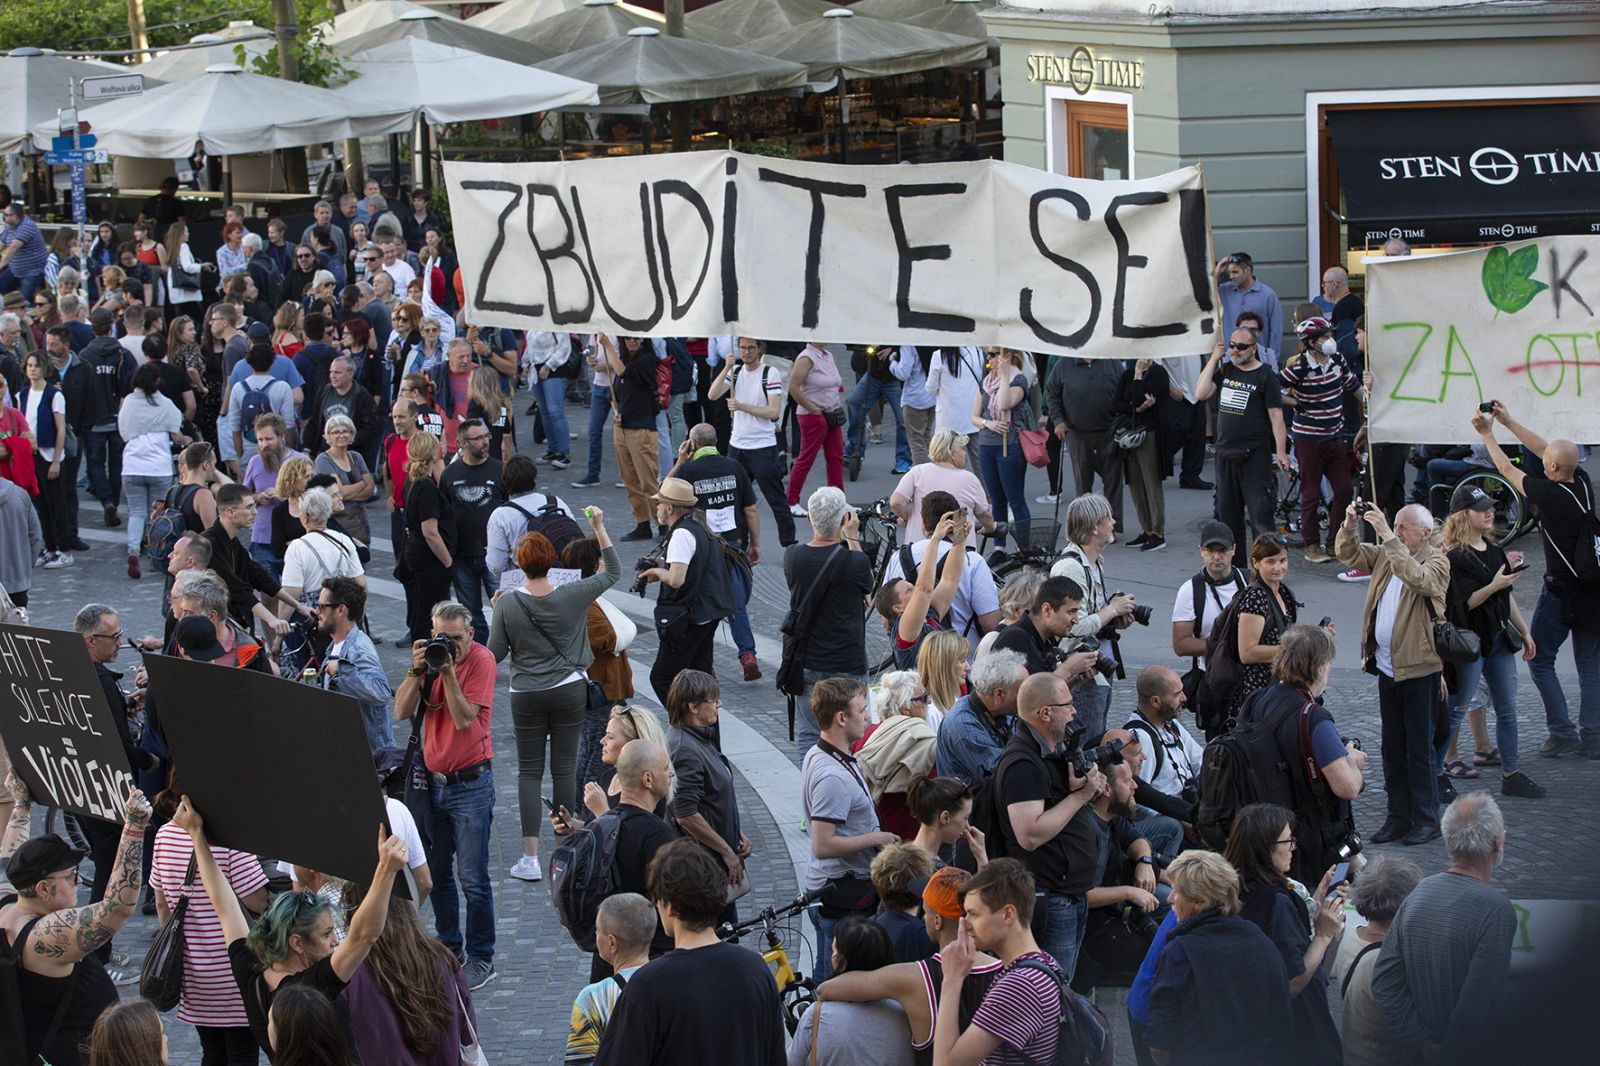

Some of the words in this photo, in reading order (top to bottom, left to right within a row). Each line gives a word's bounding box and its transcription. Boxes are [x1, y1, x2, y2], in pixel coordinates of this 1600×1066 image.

[1027, 55, 1071, 83] STEN
[1095, 59, 1144, 89] TIME
[1379, 156, 1462, 180] STEN
[1366, 231, 1388, 240] STEN
[1403, 229, 1425, 238] TIME
[1479, 227, 1500, 236] STEN
[1515, 225, 1538, 235] TIME
[1019, 188, 1214, 350] SE!
[1381, 321, 1484, 404] ZA
[1526, 331, 1600, 398] OT
[0, 632, 63, 681] HITE
[11, 682, 102, 736] SILENCE
[1307, 756, 1318, 779] Canon
